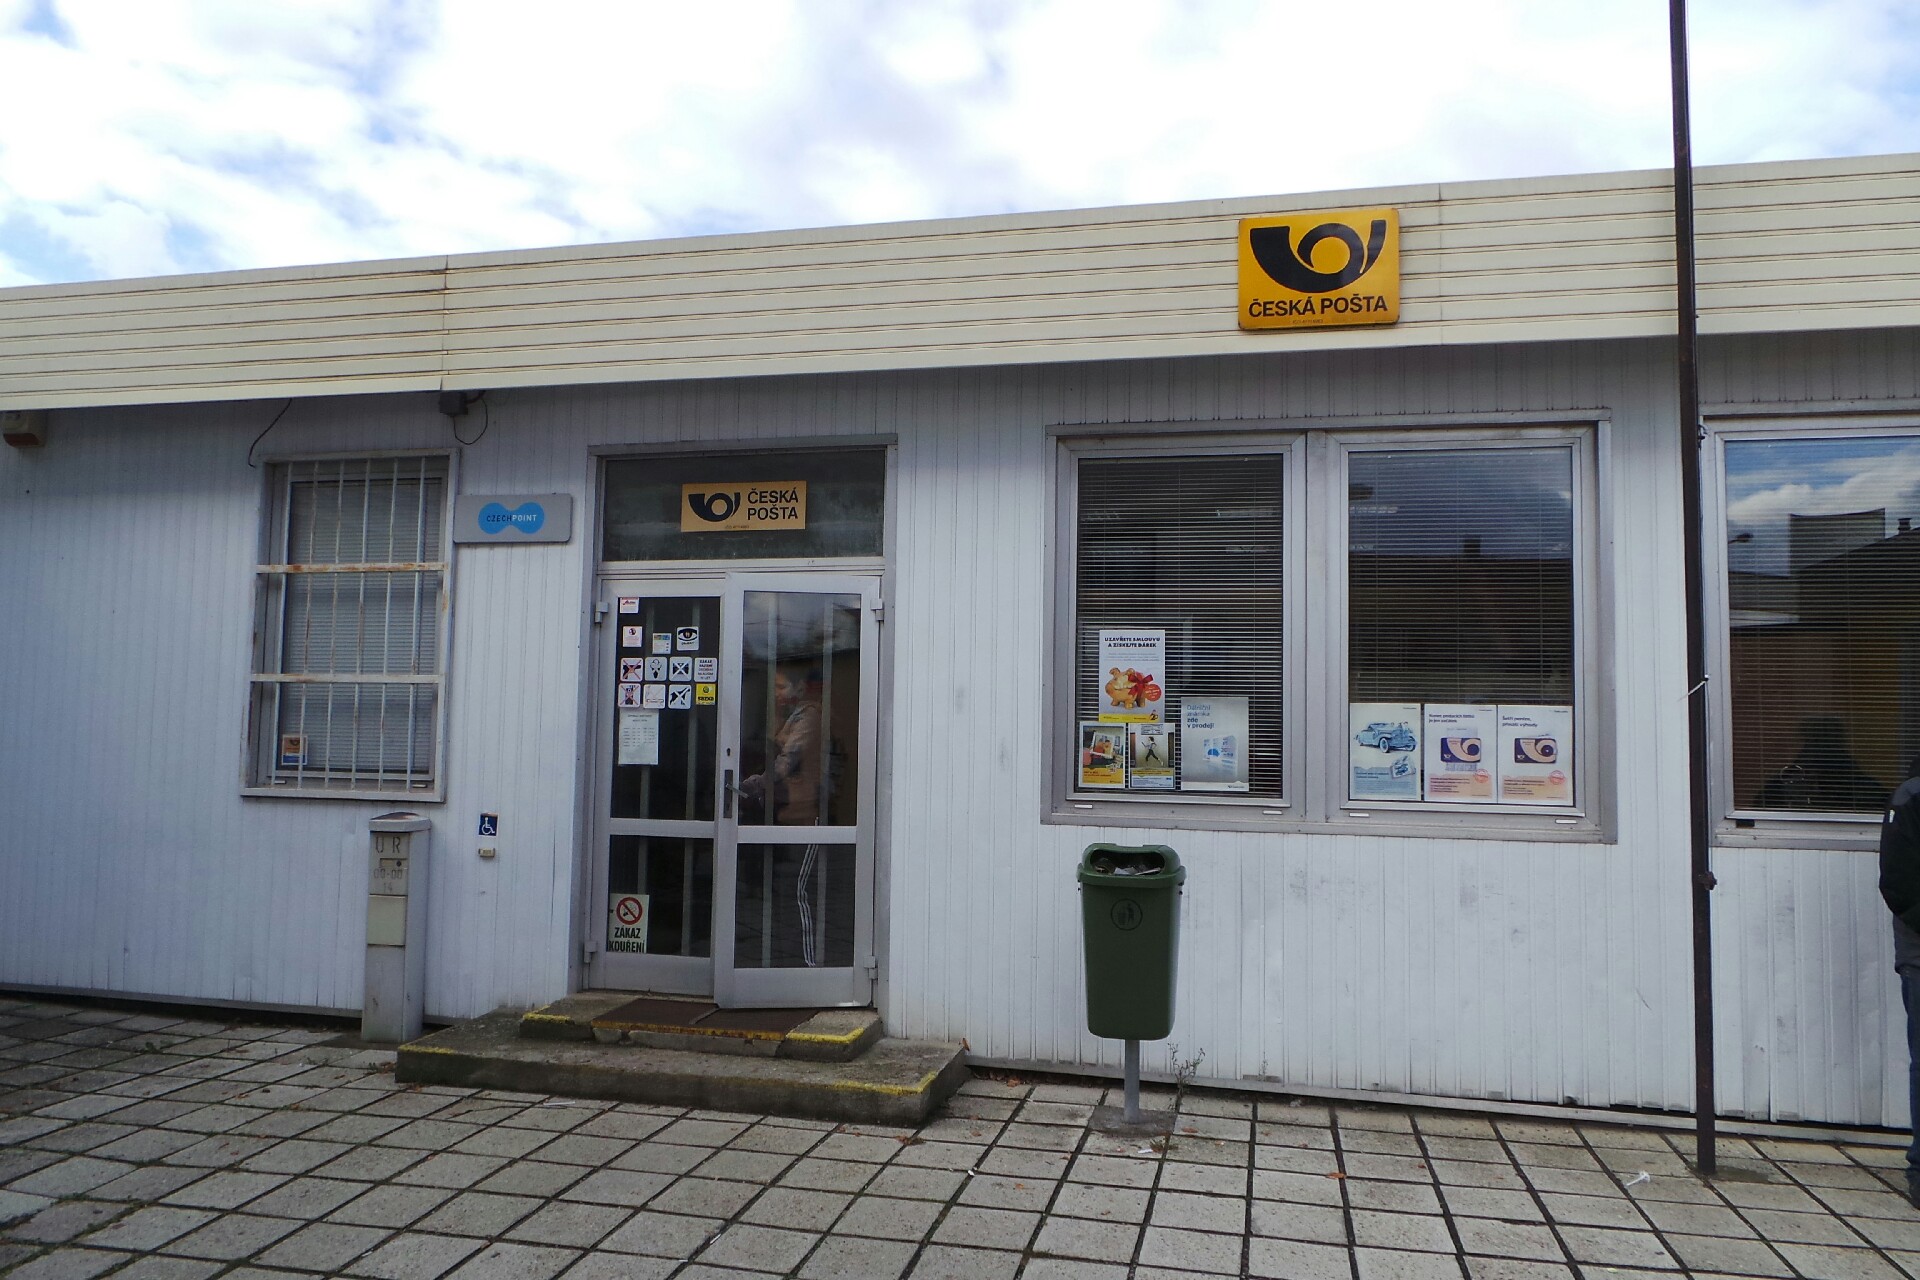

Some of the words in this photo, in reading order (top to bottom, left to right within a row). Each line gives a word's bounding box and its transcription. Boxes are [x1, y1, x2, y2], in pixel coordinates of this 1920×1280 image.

[1248, 296, 1316, 318] ČESKÁ
[1320, 293, 1388, 315] POŠTA
[747, 487, 799, 504] ČESKÁ
[747, 504, 798, 521] POŠTA
[614, 925, 641, 939] ZÁKAZ
[608, 940, 645, 953] KOUŘENÍ
